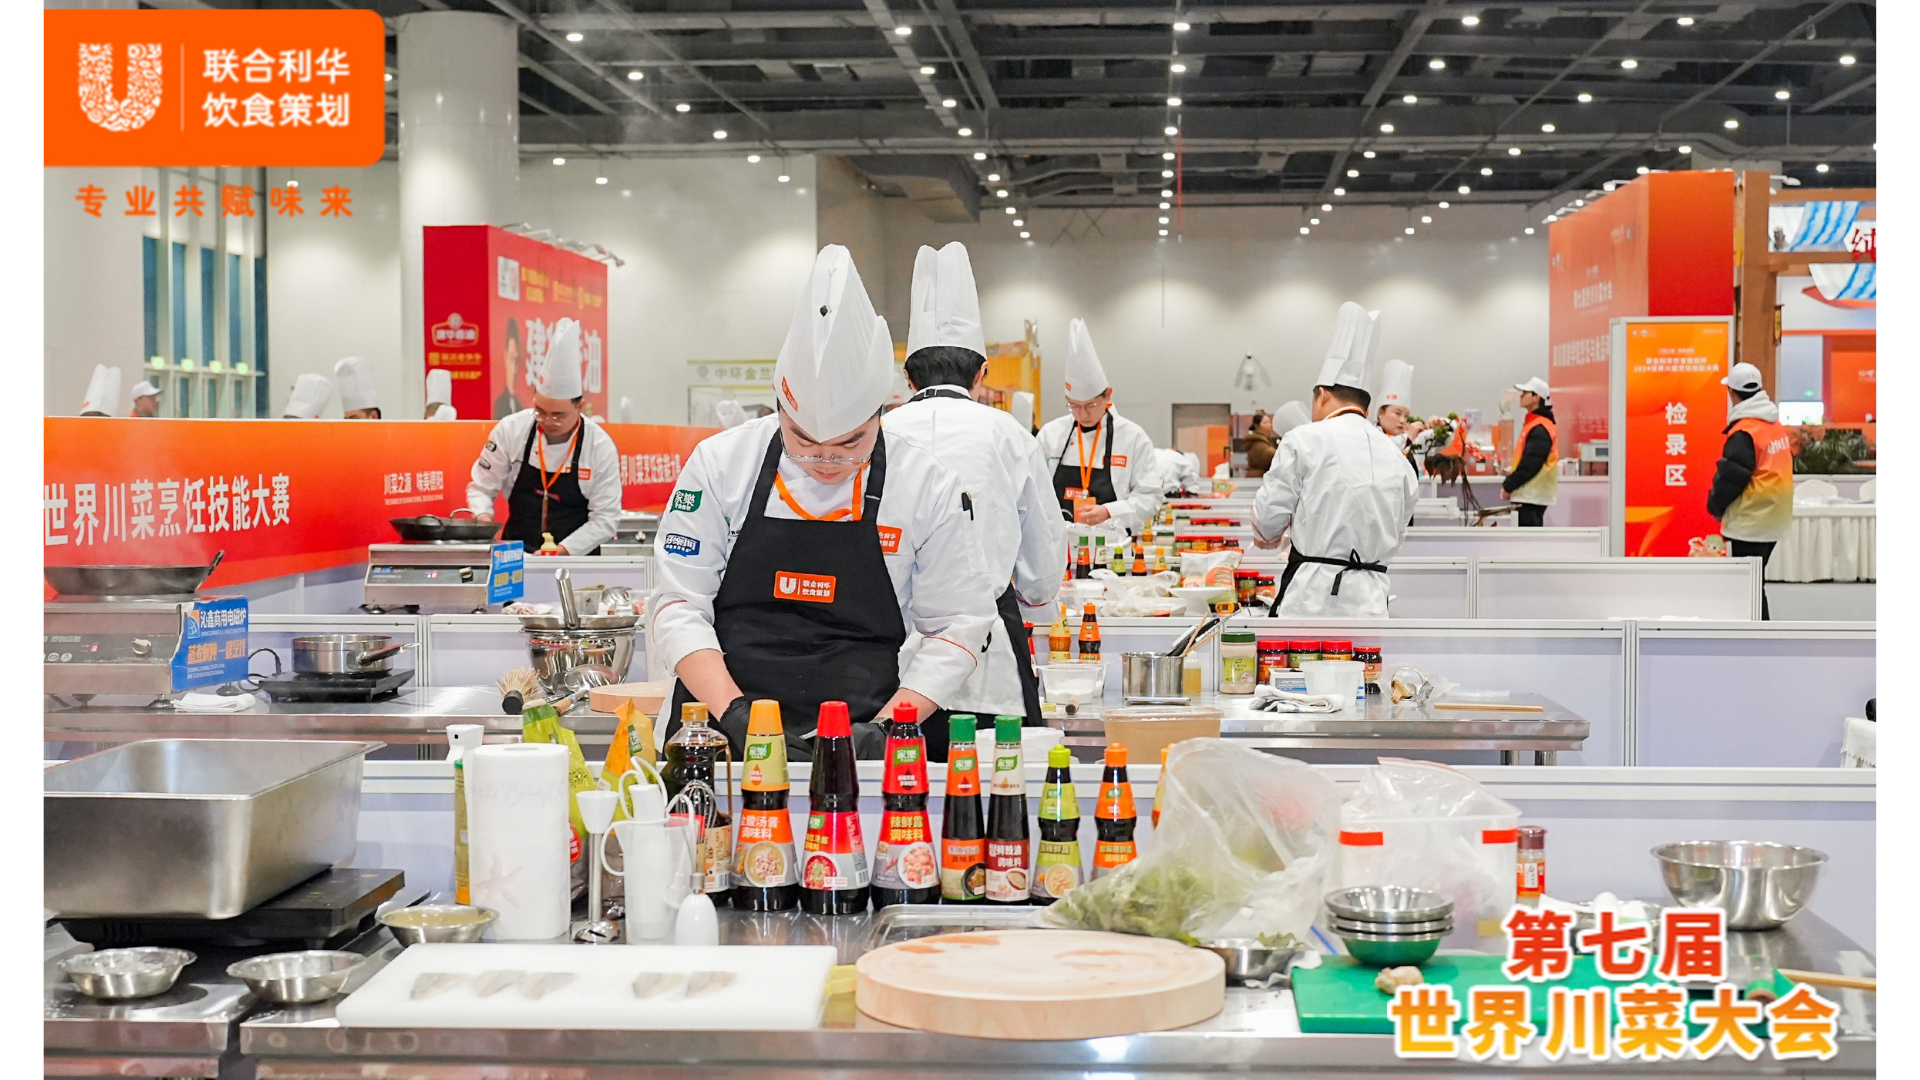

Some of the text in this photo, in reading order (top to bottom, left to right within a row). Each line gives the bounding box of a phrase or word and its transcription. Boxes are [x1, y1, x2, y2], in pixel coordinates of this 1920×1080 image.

[1664, 401, 1688, 486] 检录区
[44, 472, 290, 547] 世界川菜烹饪技能大赛
[802, 580, 830, 589] 联合利华
[802, 588, 830, 597] 饮食策划
[890, 816, 923, 828] 辣鲜露
[890, 829, 923, 841] 调味料
